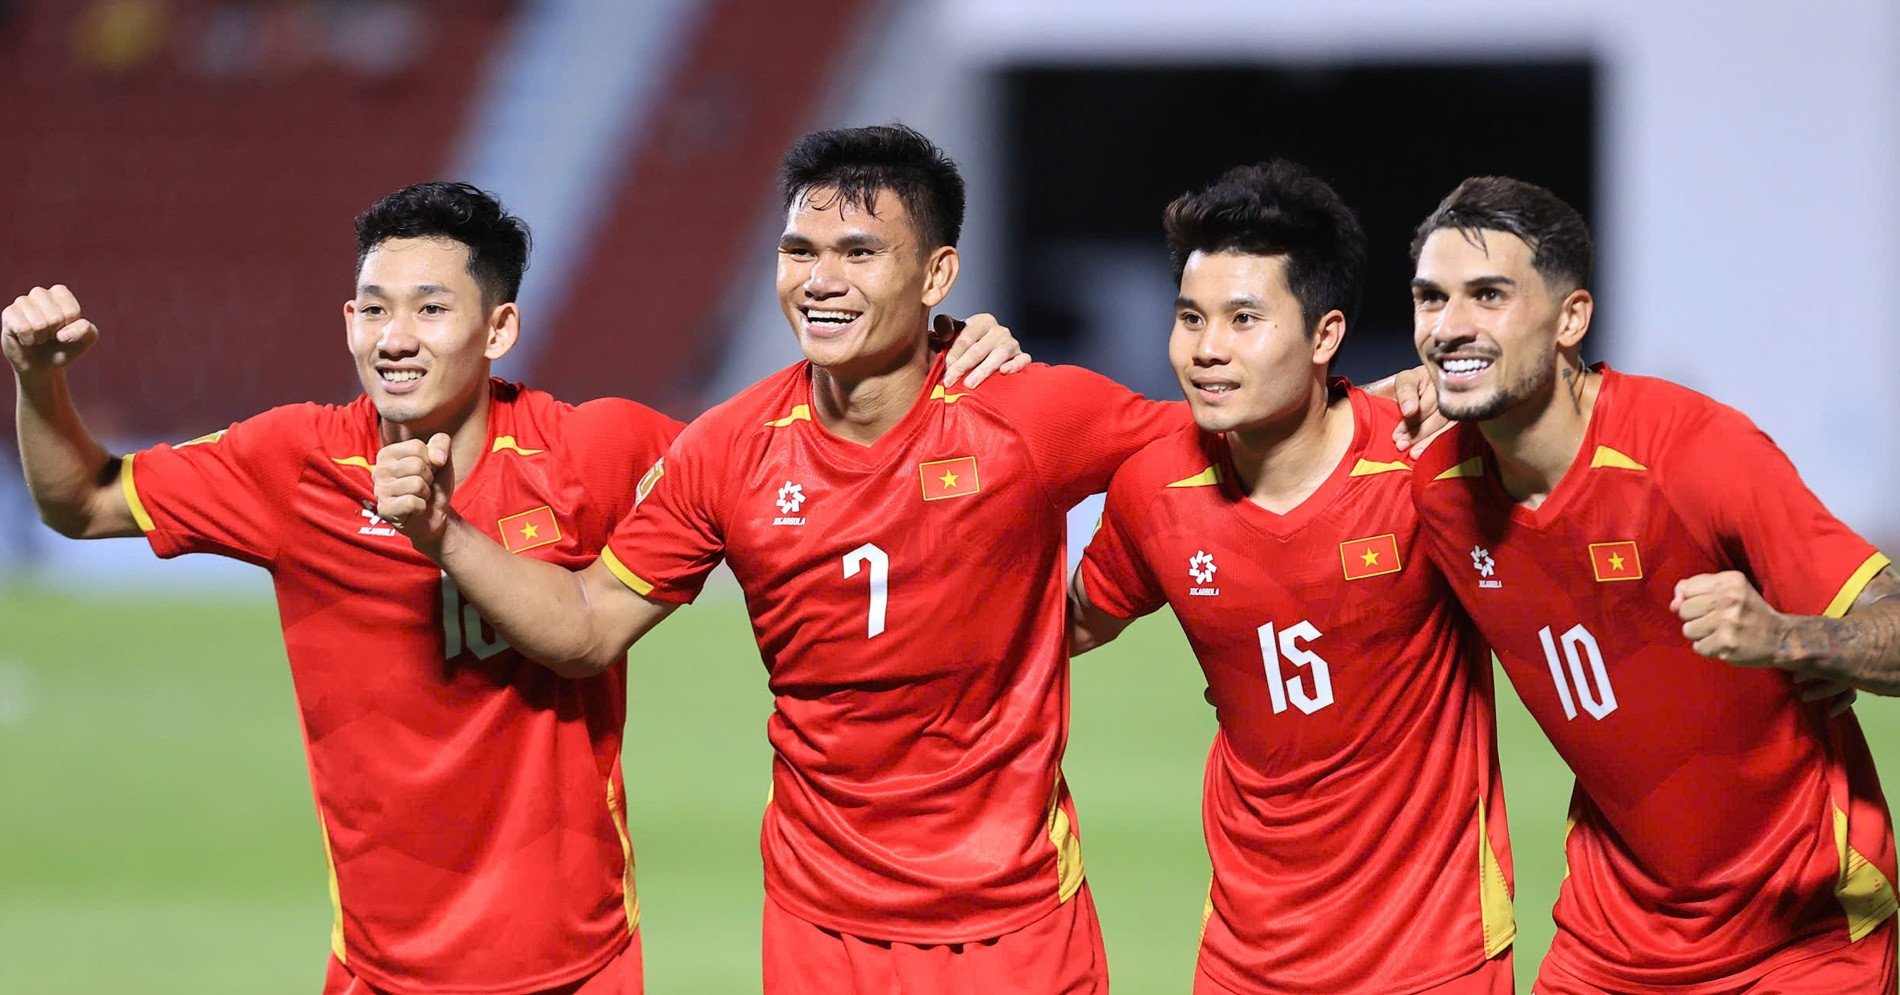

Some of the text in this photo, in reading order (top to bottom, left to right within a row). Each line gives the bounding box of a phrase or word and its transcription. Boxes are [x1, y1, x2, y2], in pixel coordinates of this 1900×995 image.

[842, 542, 889, 639] 7
[1257, 619, 1335, 716] 15
[1538, 623, 1619, 722] 10
